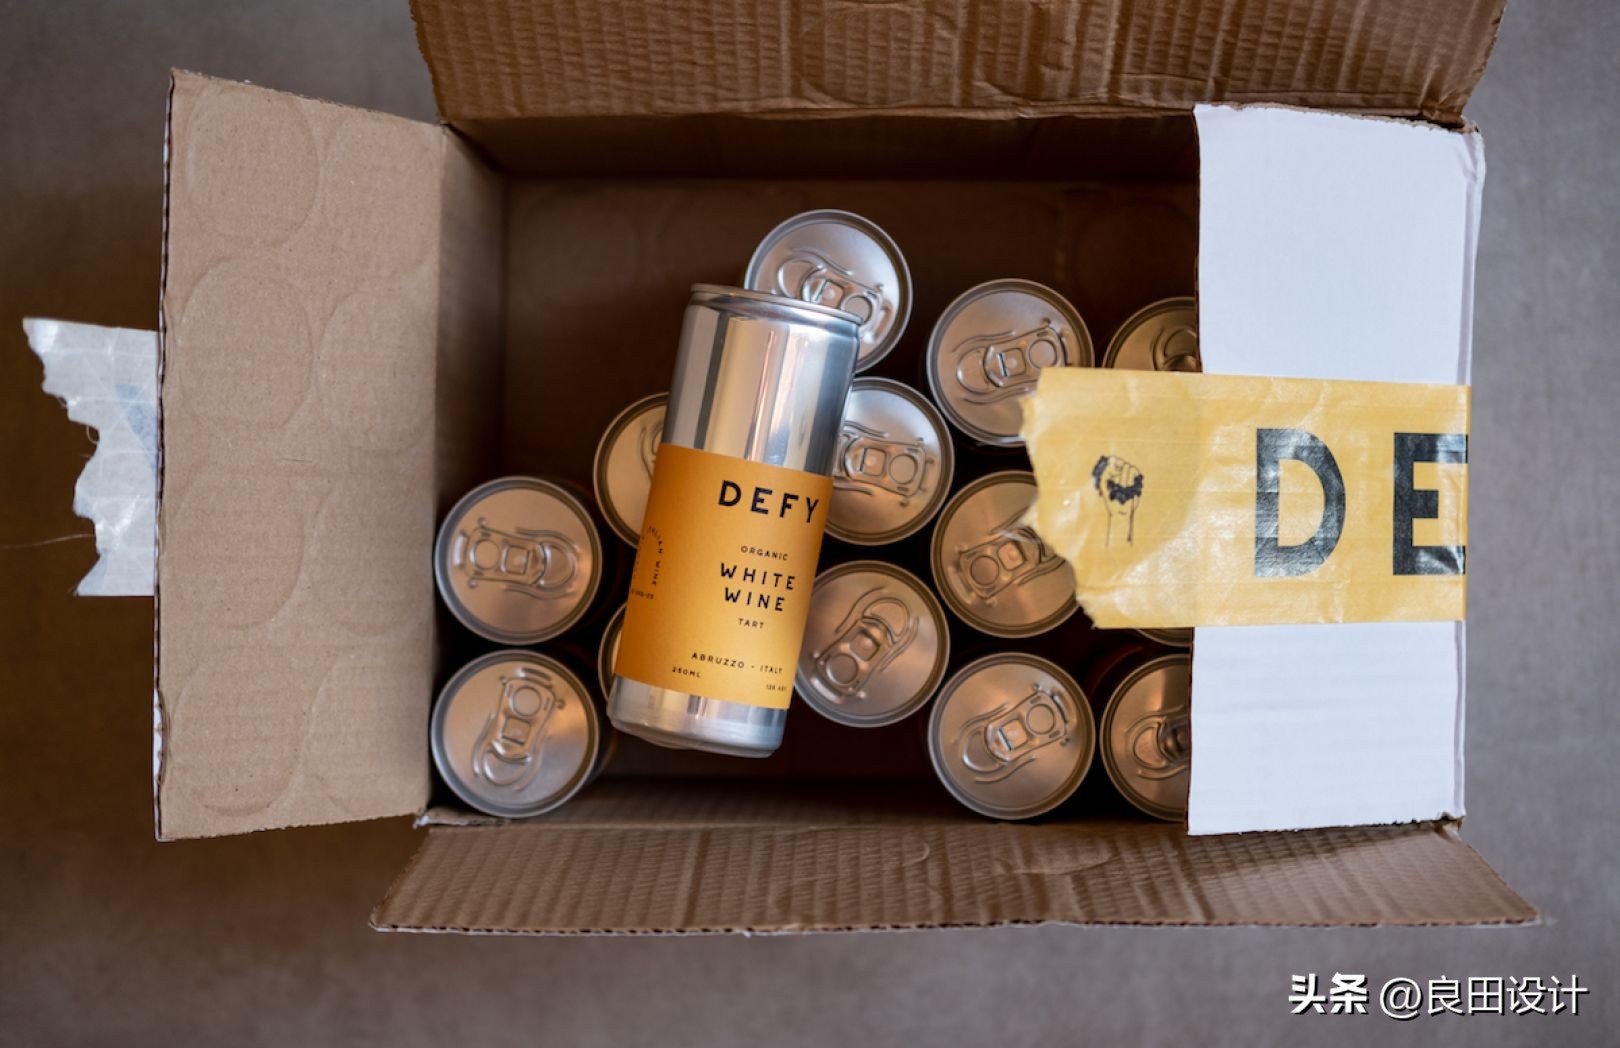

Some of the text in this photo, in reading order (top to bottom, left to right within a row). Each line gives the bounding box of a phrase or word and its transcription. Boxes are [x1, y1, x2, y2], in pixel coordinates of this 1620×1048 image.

[718, 479, 821, 524] DEFY
[1254, 427, 1469, 577] DE
[740, 544, 790, 562] ORGANIC
[719, 562, 797, 591] WHITE
[724, 586, 786, 612] WINE
[737, 617, 765, 630] TART
[671, 665, 702, 679] 250ML
[690, 651, 746, 669] ABRUZZO
[759, 664, 784, 675] ITALY
